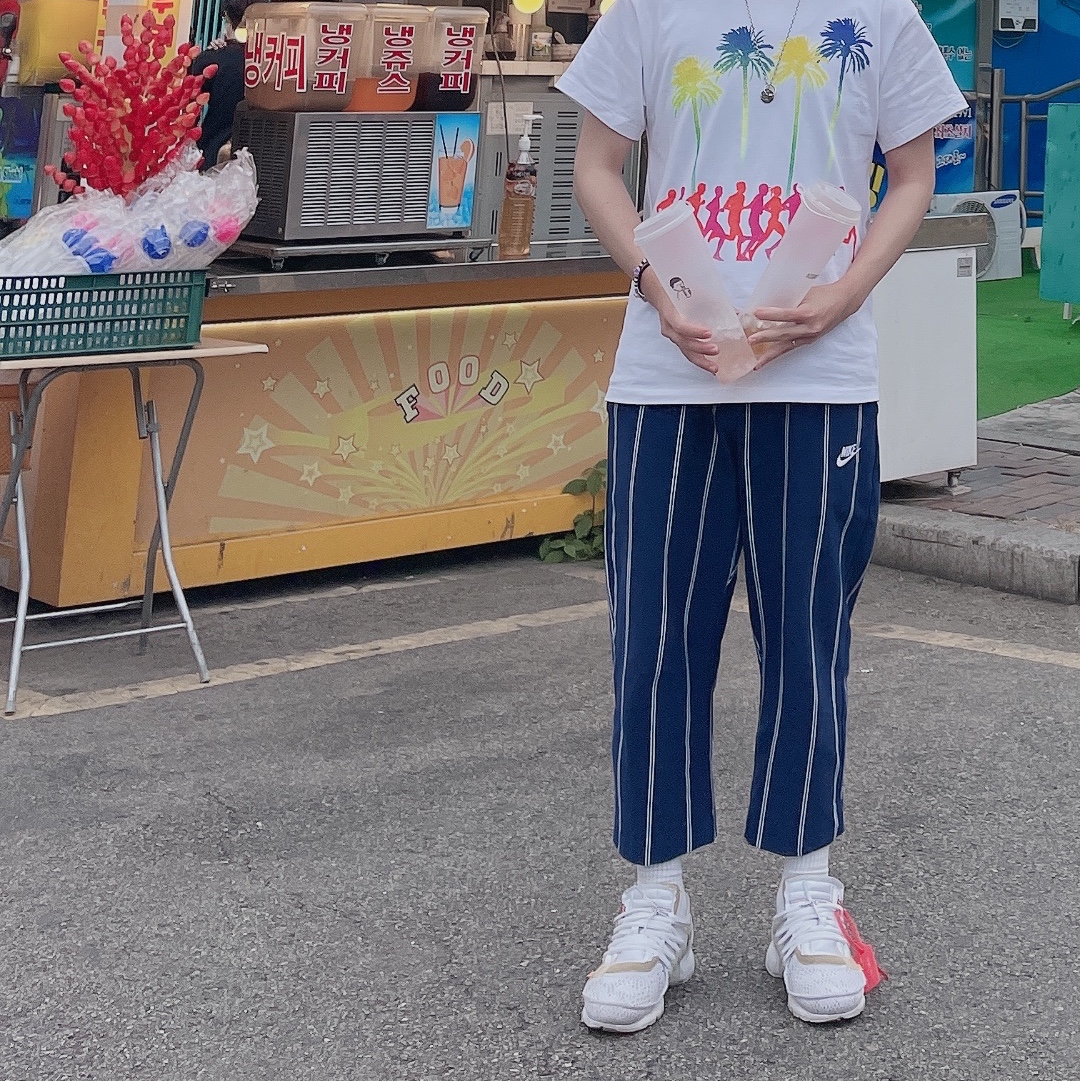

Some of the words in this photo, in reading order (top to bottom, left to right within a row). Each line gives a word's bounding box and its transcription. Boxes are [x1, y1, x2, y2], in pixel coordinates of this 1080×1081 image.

[245, 31, 307, 93] 냉커피
[313, 23, 353, 94] 냉커피
[377, 24, 415, 94] 냉쥬스
[439, 24, 476, 94] 냉커피
[394, 354, 510, 424] FOOD
